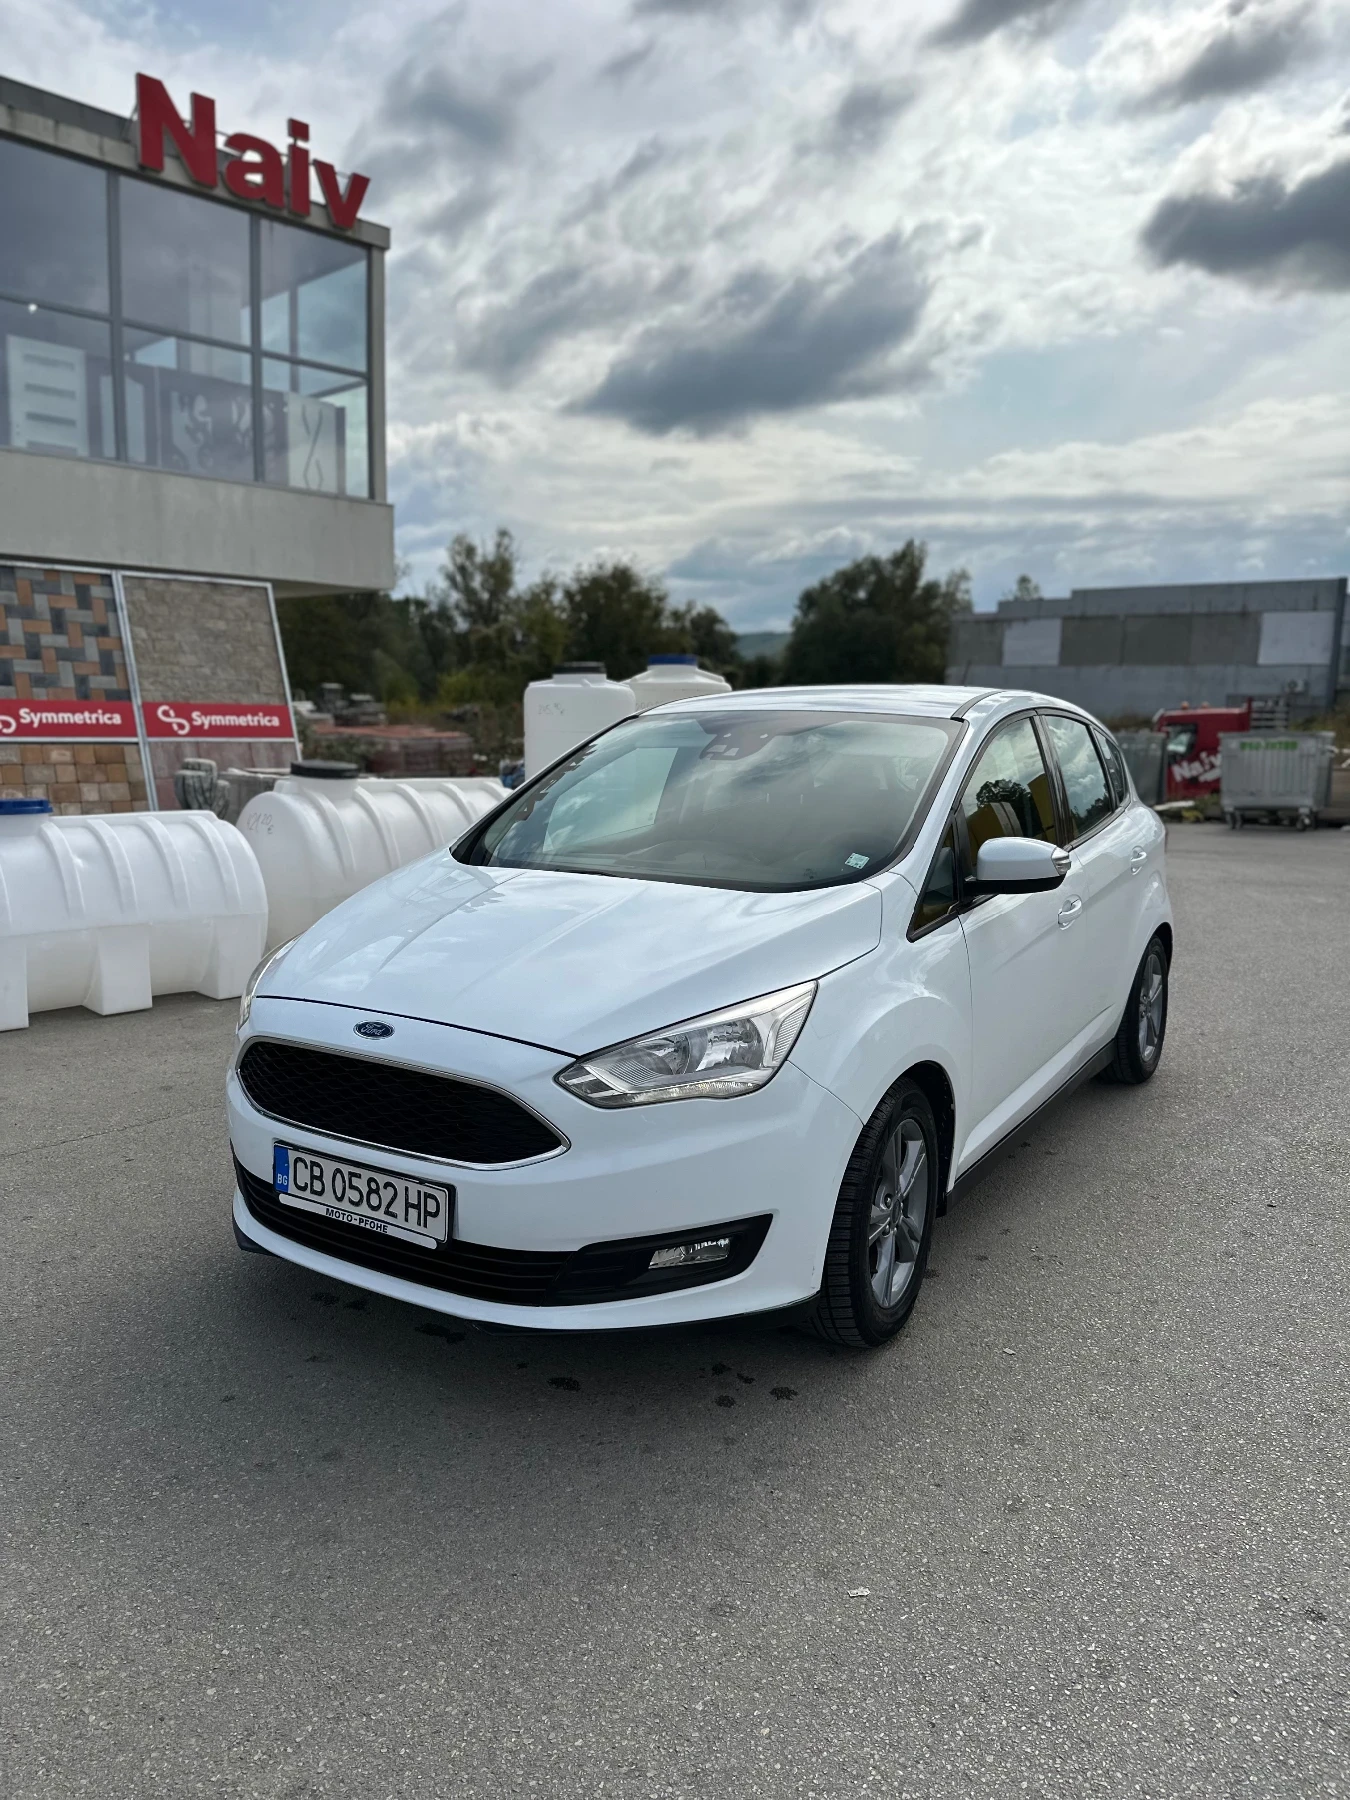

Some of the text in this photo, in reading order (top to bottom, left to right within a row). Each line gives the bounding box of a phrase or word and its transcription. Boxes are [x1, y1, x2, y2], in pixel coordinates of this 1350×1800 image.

[136, 72, 371, 229] Naiv
[19, 707, 122, 728] Symmetrica
[191, 711, 280, 729] Symmetrica
[360, 1023, 385, 1035] Ford
[277, 1156, 441, 1229] BG CB 0582 HP
